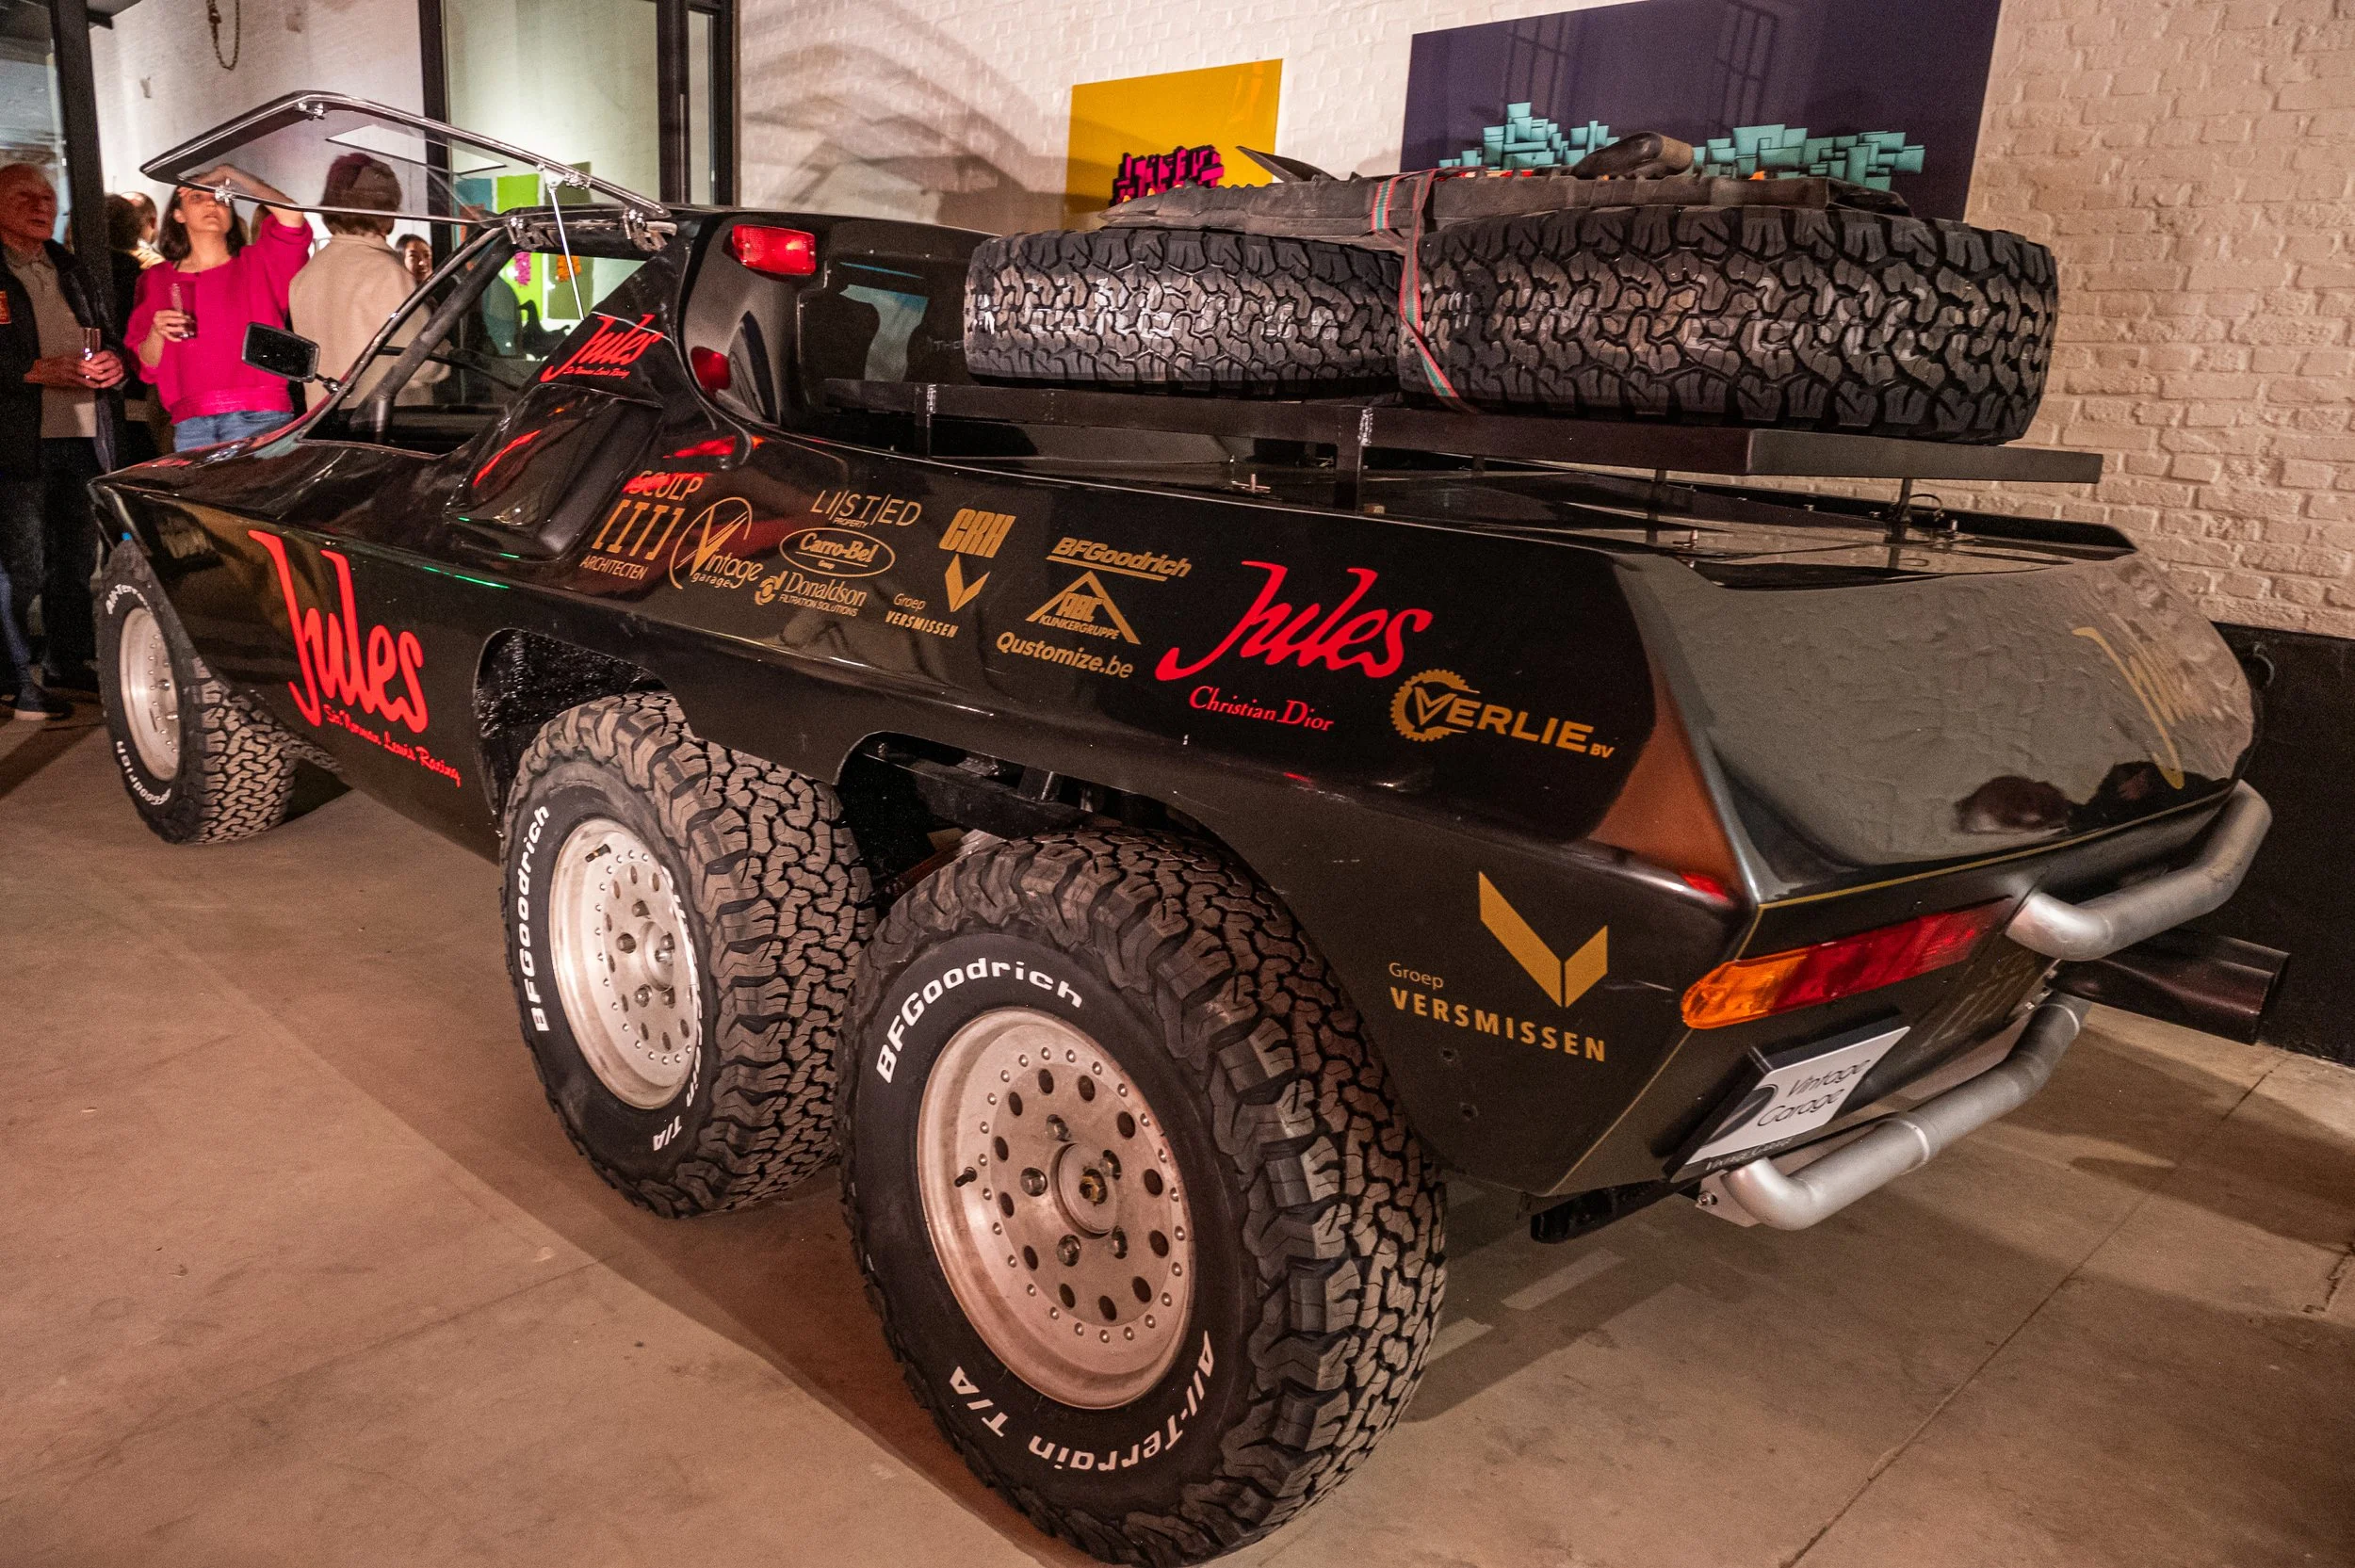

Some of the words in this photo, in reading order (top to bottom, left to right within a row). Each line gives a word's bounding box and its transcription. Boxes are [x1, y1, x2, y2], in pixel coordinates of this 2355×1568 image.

[540, 314, 664, 382] Jules
[832, 517, 869, 529] PROPERTY
[579, 555, 649, 580] ARCHITECTEN
[800, 532, 880, 563] Carro-Bel
[1050, 537, 1193, 578] BFGoodrich
[690, 573, 731, 589] garage
[783, 571, 869, 607] Donaldson
[893, 592, 927, 611] Groep
[247, 529, 430, 735] Jules
[885, 610, 960, 639] VERSMISSEN
[1038, 614, 1121, 640] KLINKERGRUPPE
[1155, 559, 1435, 682] Jules
[996, 632, 1134, 680] Qustomize.be
[1189, 685, 1277, 723] Christian
[1276, 699, 1335, 734] Dior
[1415, 686, 1594, 754] VERLIE
[1589, 741, 1616, 759] BV
[517, 805, 550, 1032] BFGoodrich
[1388, 961, 1445, 991] Groep
[874, 955, 1085, 1084] BFGoodrich
[1389, 985, 1606, 1063] VERSMISSEN
[1786, 1058, 1872, 1099] Vintage
[1756, 1088, 1845, 1127] Garage
[947, 1365, 1010, 1438] T/A
[1027, 1330, 1216, 1473] All-Terrain
